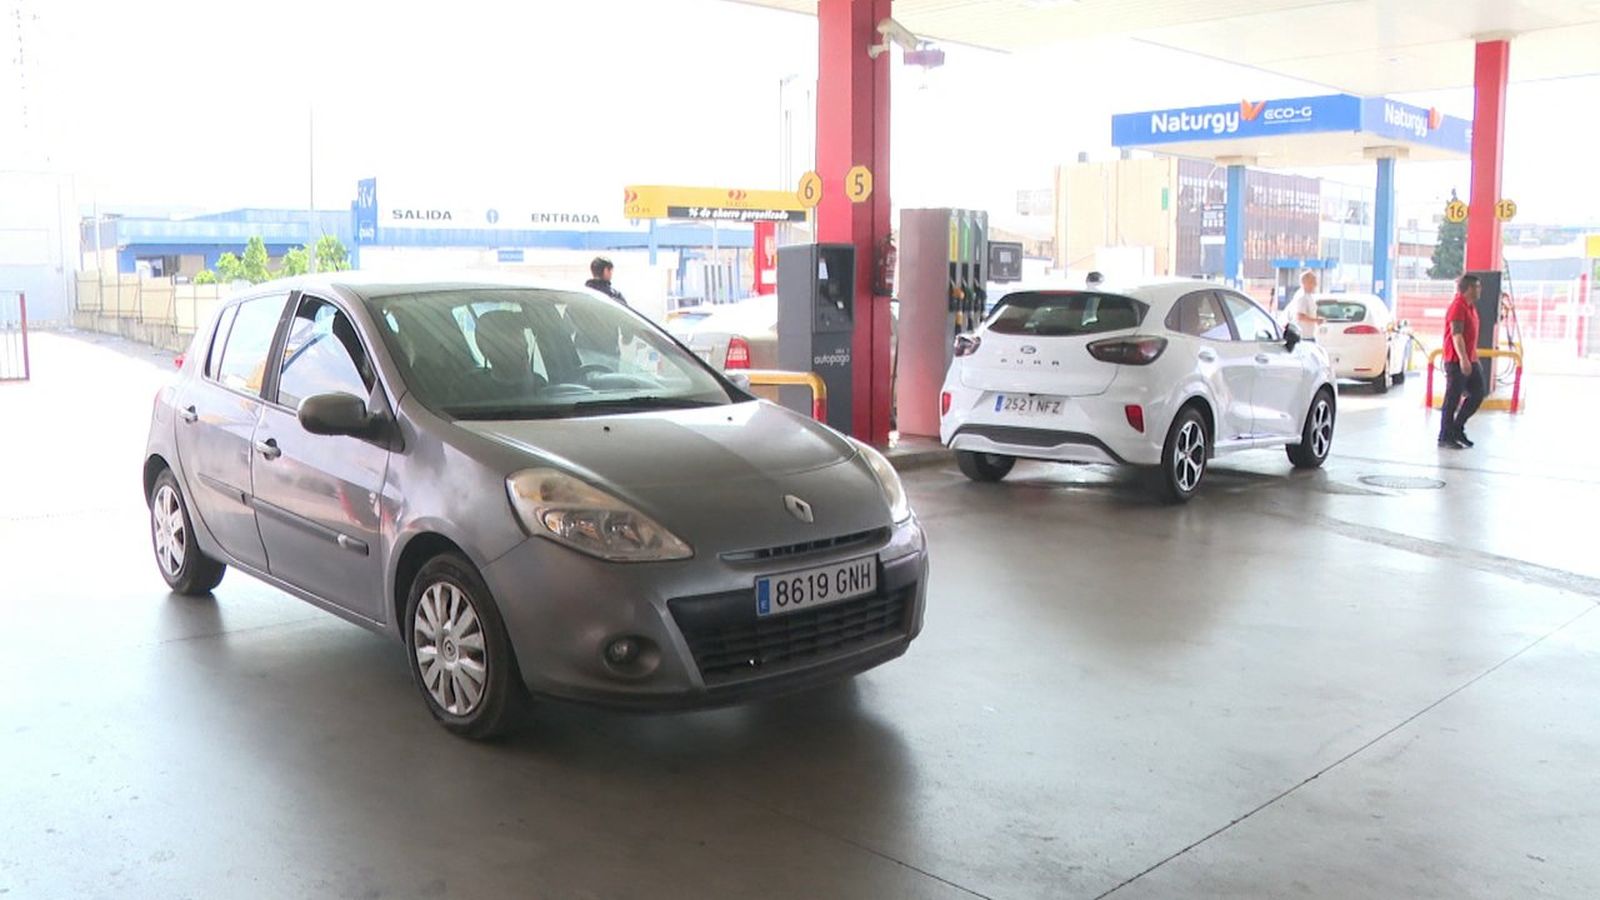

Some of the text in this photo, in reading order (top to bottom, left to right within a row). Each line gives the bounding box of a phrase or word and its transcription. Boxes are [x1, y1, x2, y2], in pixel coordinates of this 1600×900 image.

[1150, 111, 1239, 134] Naturgy
[1384, 101, 1428, 138] Naturgy
[804, 179, 814, 198] 6
[853, 172, 865, 196] 5
[392, 209, 452, 221] SALIDA
[531, 212, 600, 224] ENTRADA
[700, 208, 711, 218] de
[1449, 204, 1464, 219] 16
[1498, 203, 1513, 218] 15
[814, 353, 849, 366] autopago
[1004, 397, 1061, 414] 2521 NFZ
[776, 563, 871, 607] 8619 GNH
